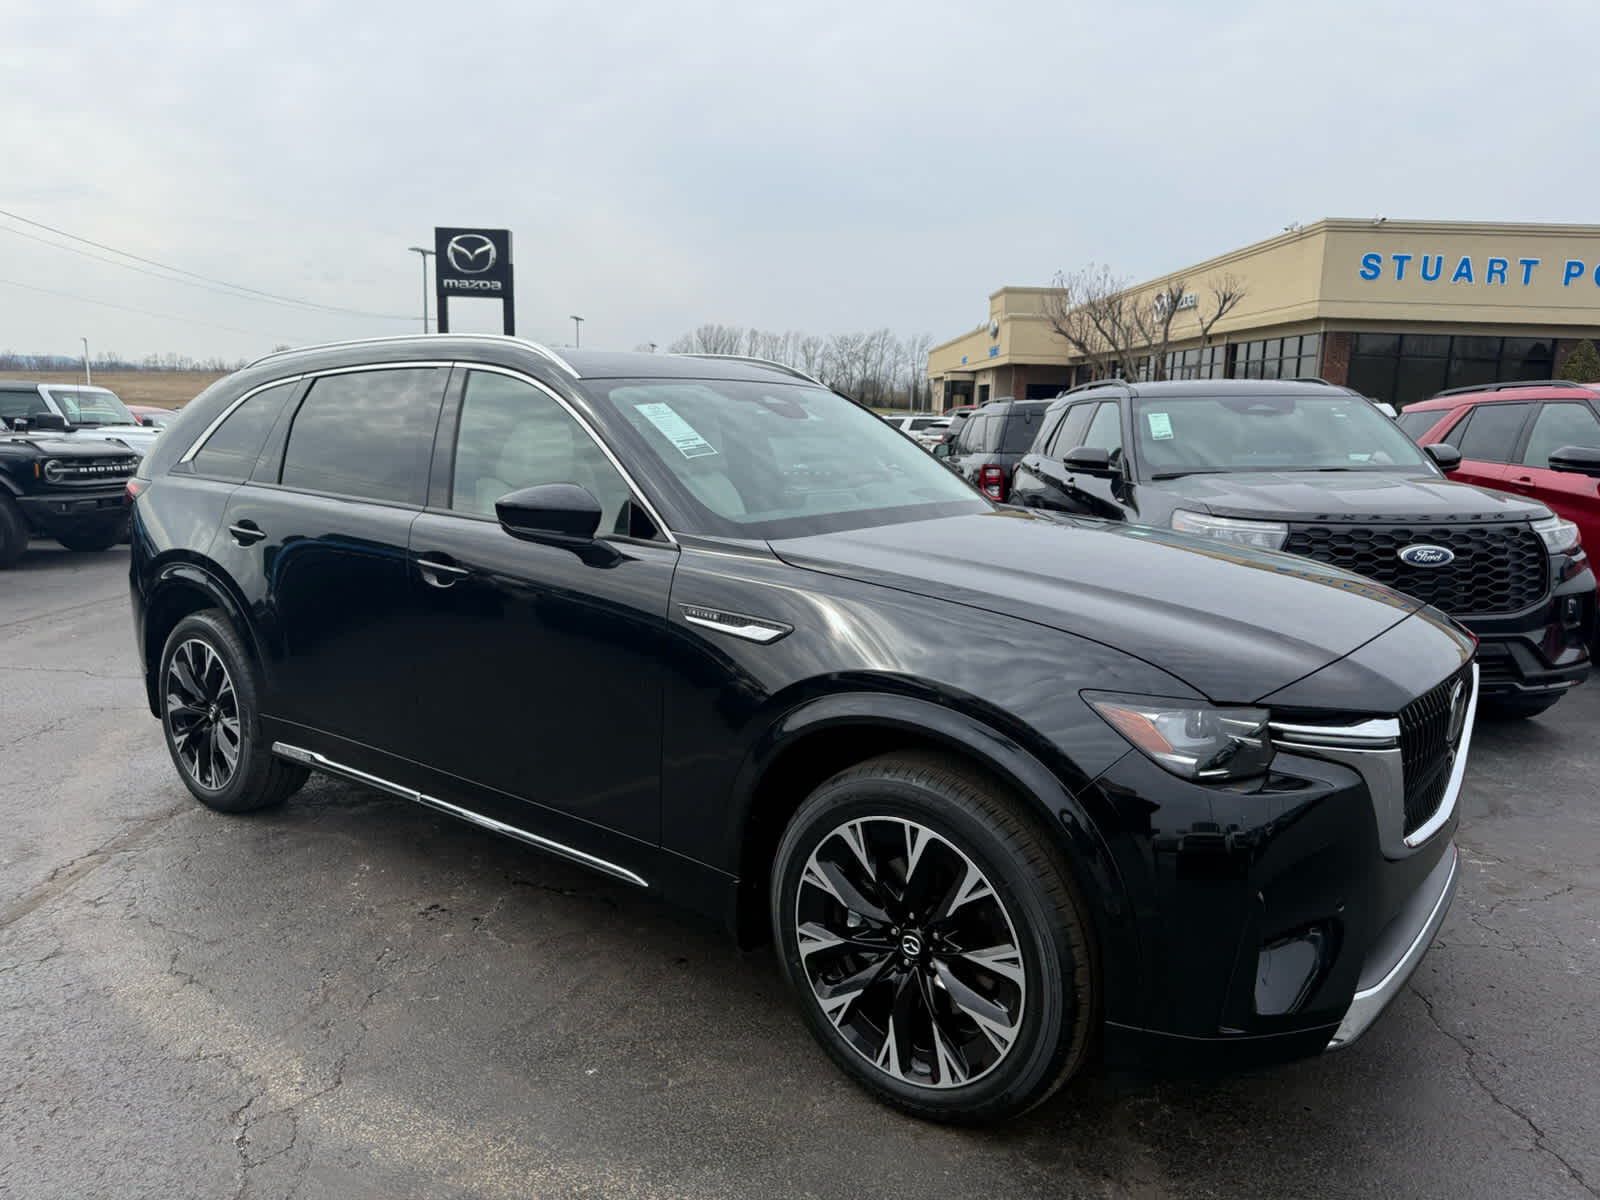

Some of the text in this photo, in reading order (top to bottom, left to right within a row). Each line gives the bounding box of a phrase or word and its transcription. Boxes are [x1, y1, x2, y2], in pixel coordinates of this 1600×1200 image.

[1359, 252, 1540, 285] STUART
[443, 279, 502, 290] mazda
[1414, 550, 1442, 562] Ford
